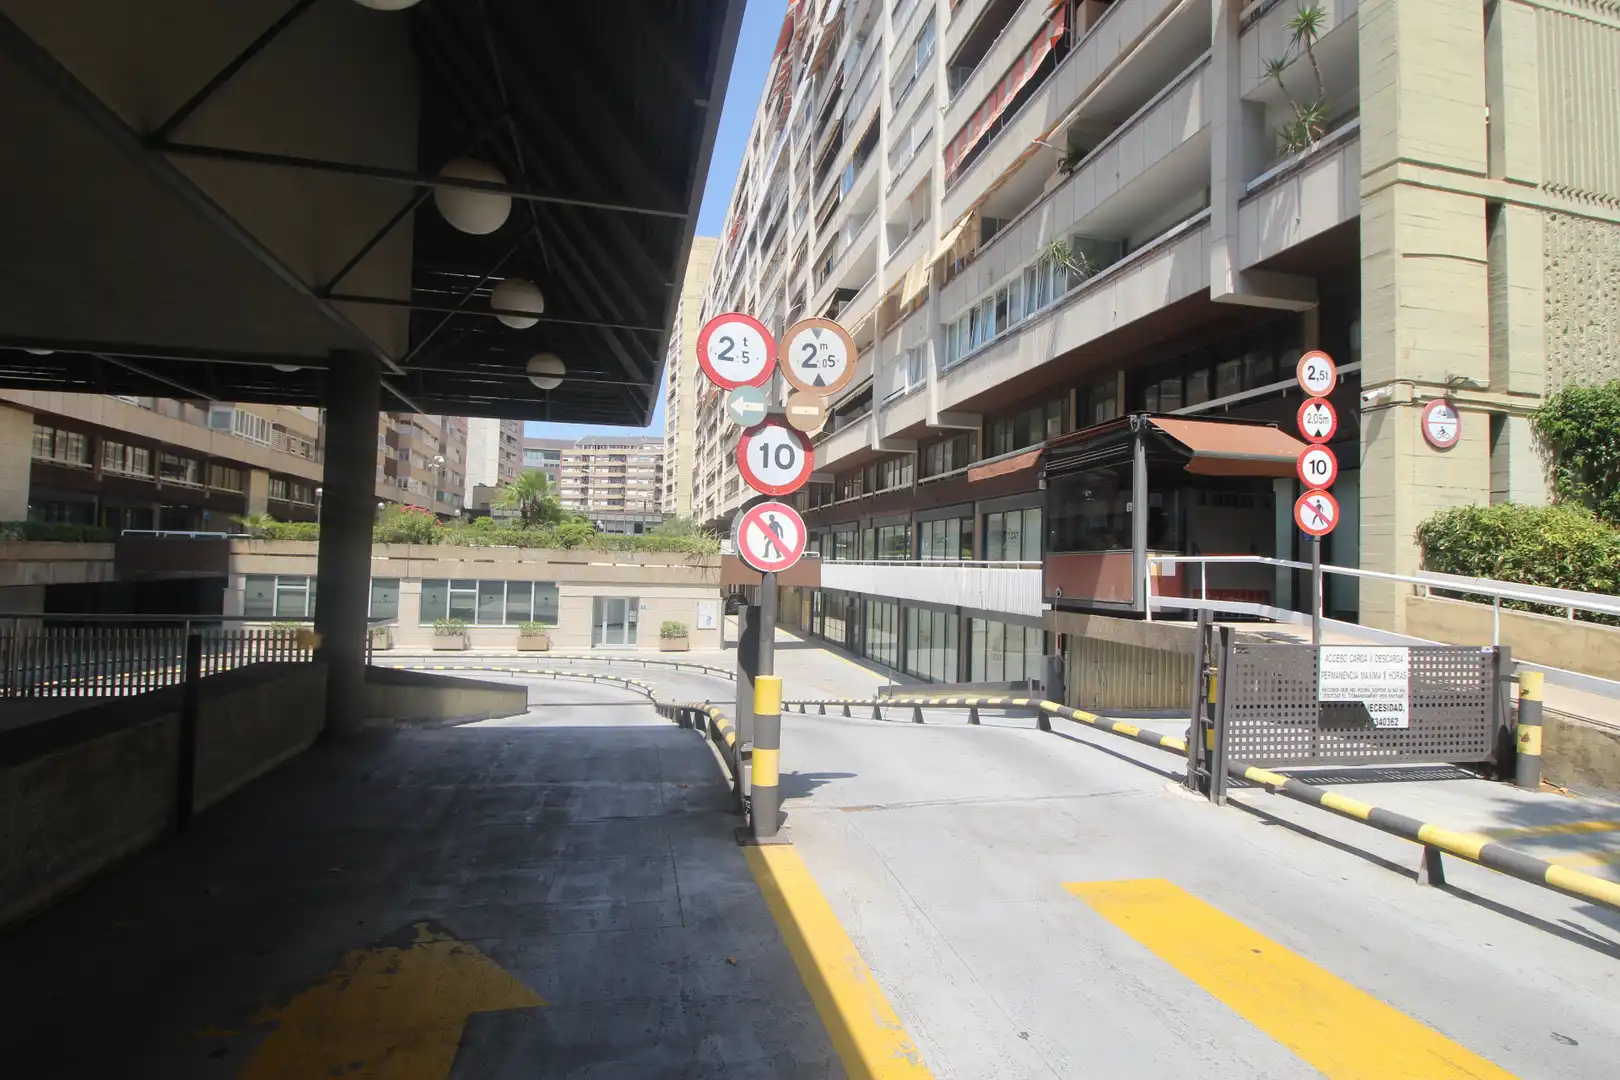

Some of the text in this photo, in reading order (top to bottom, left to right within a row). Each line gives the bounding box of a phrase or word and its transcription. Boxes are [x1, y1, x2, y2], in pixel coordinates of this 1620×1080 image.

[759, 442, 796, 470] 10
[1308, 459, 1327, 475] 10
[1324, 653, 1348, 663] ACCESO
[1350, 653, 1368, 664] CARGA
[1375, 654, 1404, 664] DESCARGA
[1388, 670, 1407, 680] HORAS
